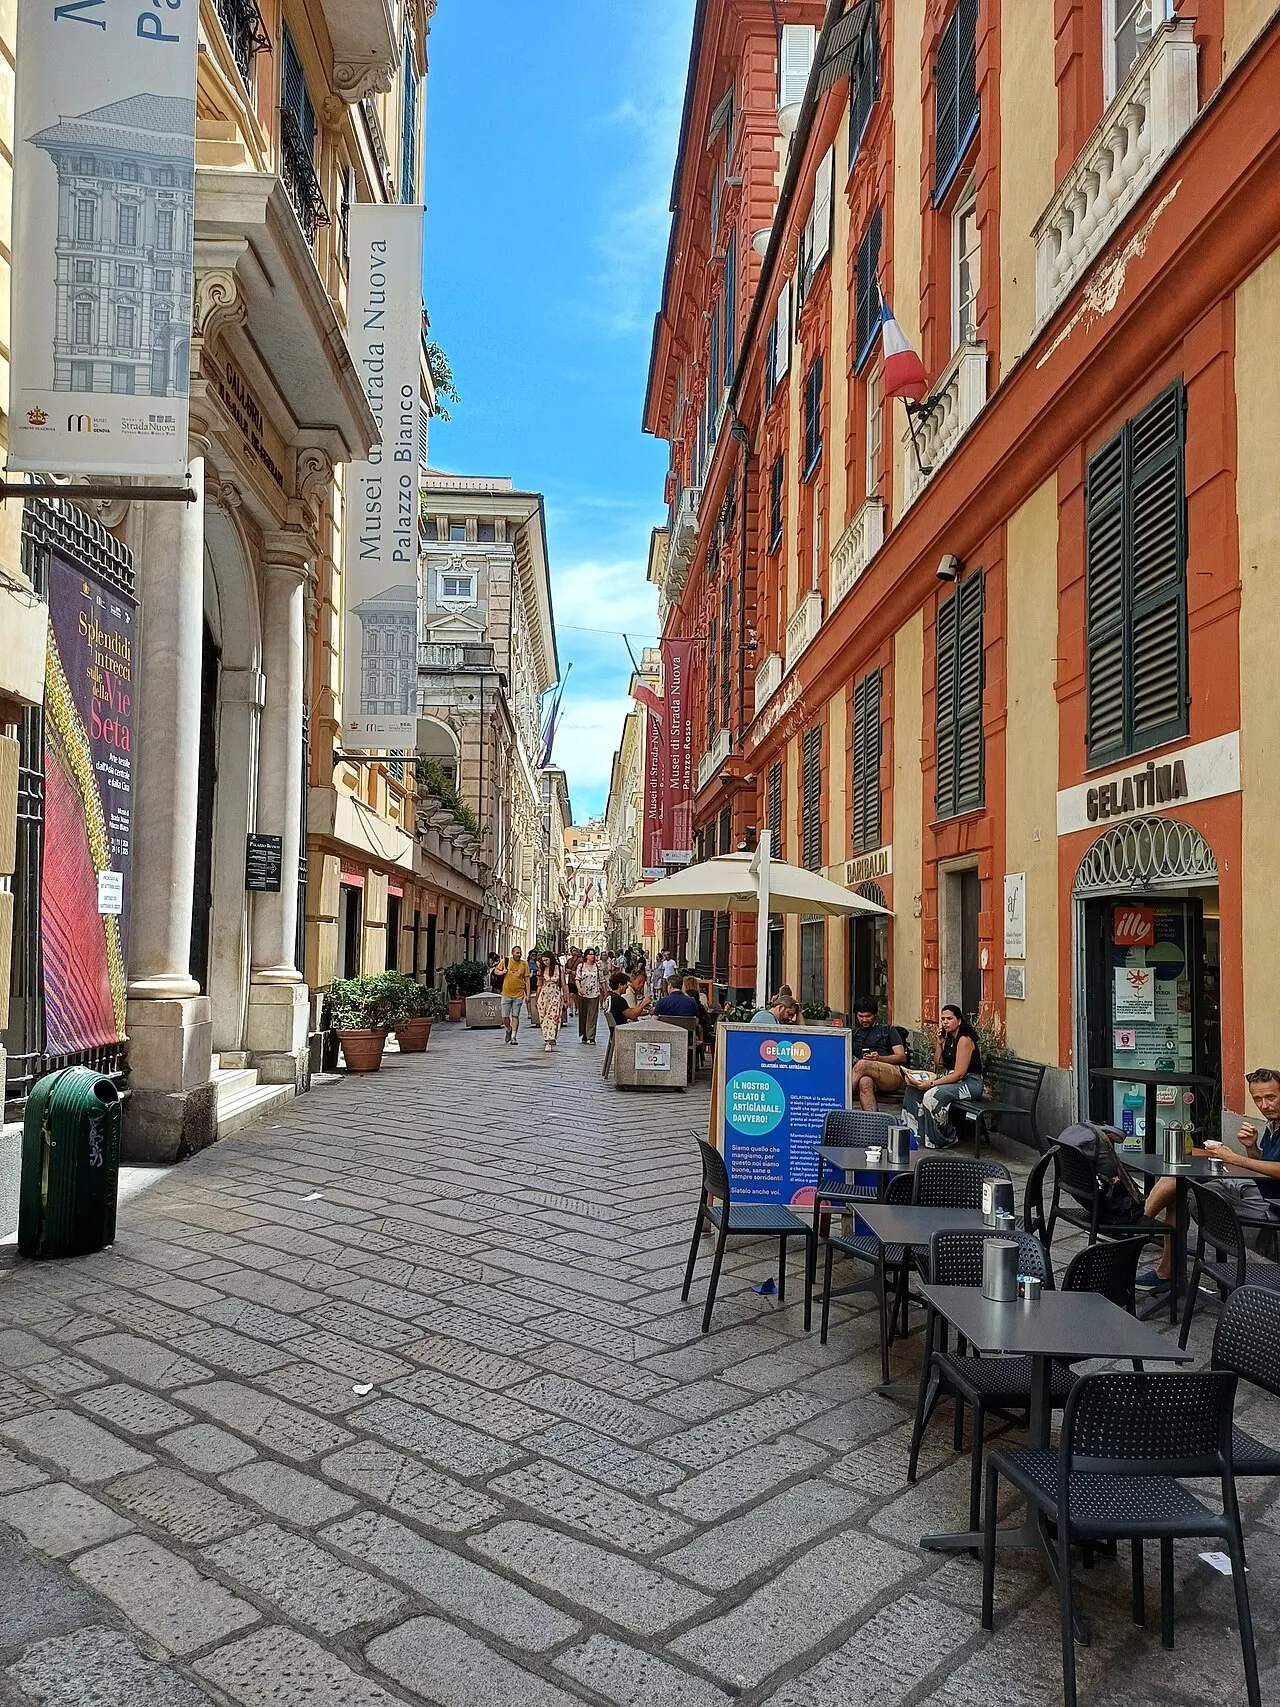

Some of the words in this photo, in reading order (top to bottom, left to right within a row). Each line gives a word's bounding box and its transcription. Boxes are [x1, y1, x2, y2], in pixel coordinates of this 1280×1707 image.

[364, 239, 387, 331] Nuova
[363, 343, 385, 429] trada
[393, 384, 413, 462] Bianco
[360, 476, 382, 561] Musei
[392, 474, 412, 563] Palazzo
[78, 610, 131, 662] Splendidi
[86, 666, 103, 684] sulle
[94, 644, 131, 682] intrecci
[670, 657, 681, 695] Nuova
[92, 681, 109, 702] della
[103, 671, 131, 718] Vie
[90, 697, 131, 752] Seta
[670, 699, 681, 735] Strada
[683, 720, 691, 750] Rosso
[650, 744, 659, 776] Strada
[670, 737, 680, 750] di
[650, 776, 658, 788] di
[670, 752, 680, 789] Musei
[683, 752, 691, 790] Palazzo
[648, 790, 658, 819] Musei
[1116, 912, 1151, 943] illy
[733, 1092, 759, 1101] GELATO
[760, 1092, 765, 1101] È
[741, 1081, 769, 1091] NOSTRO
[733, 1114, 768, 1123] DAVVERO!
[732, 1152, 763, 1160] mangiamo,
